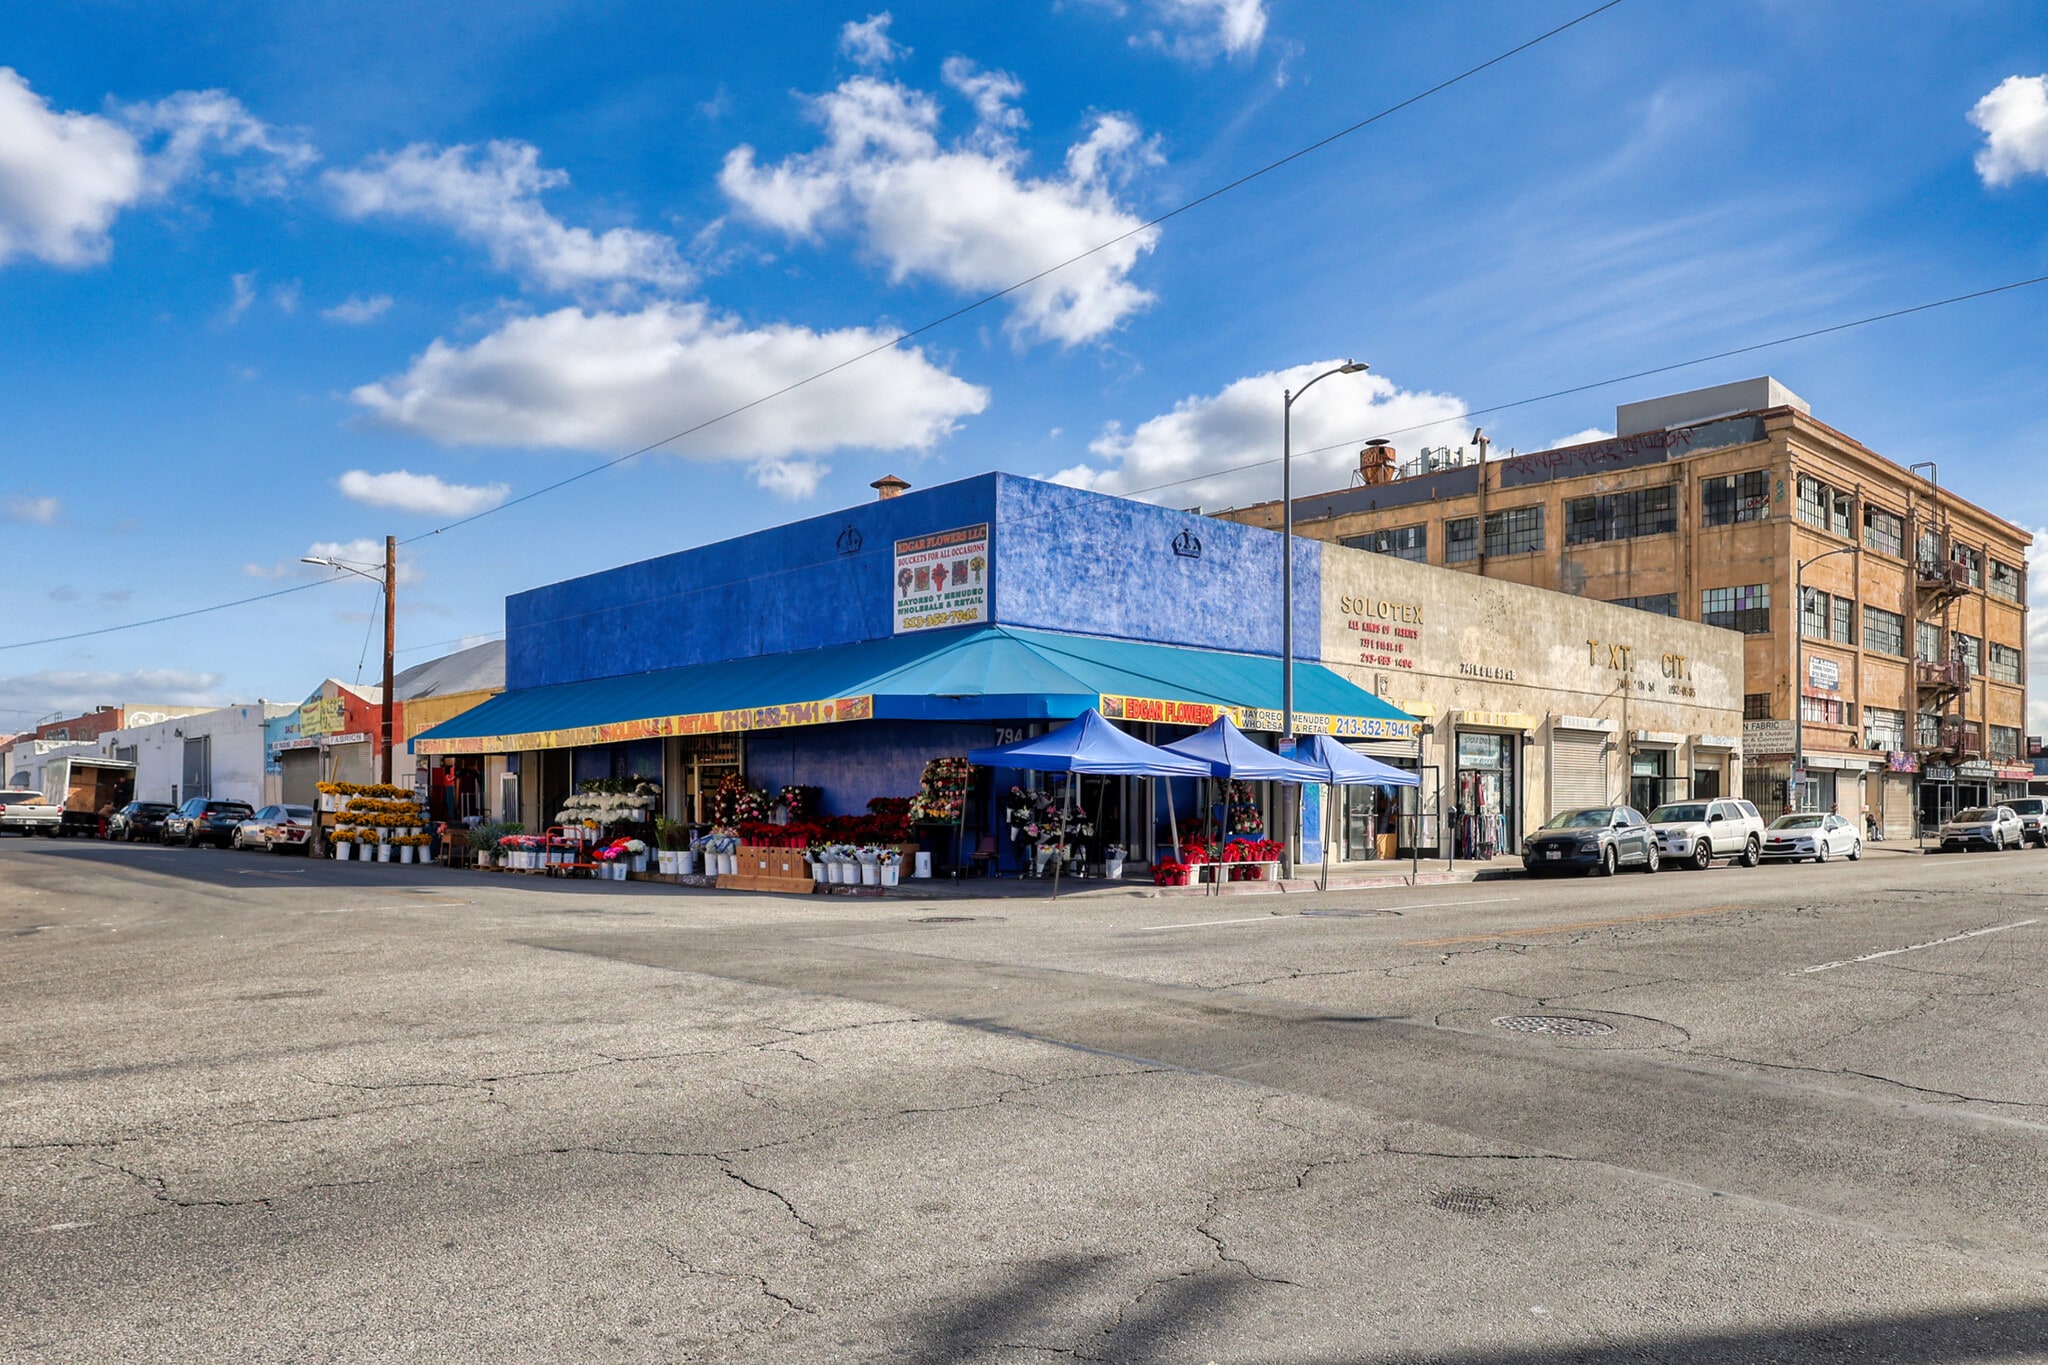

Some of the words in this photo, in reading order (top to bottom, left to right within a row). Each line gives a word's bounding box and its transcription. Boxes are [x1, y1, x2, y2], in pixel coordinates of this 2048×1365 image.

[898, 540, 926, 554] EDGAR
[927, 531, 967, 549] FLOWERS
[967, 527, 985, 539] LLC
[898, 553, 926, 566] BOUCKETS
[928, 551, 938, 560] FOR
[940, 549, 951, 559] ALL
[952, 543, 984, 556] OCCASIONS
[898, 595, 933, 607] MAYOREO
[944, 588, 983, 599] MENUDEO
[898, 602, 943, 615] WHOLESALE
[946, 600, 951, 608] &
[954, 598, 983, 606] RETAIL
[903, 608, 977, 628] 213-352-7941
[1341, 595, 1423, 625] SOLOTEX
[1126, 698, 1163, 720] EDGAR
[1165, 703, 1213, 724] FLOWERS
[1241, 709, 1282, 721] MAYOREO
[1292, 714, 1330, 725] MENUDEO
[600, 719, 659, 741] WHOLESALE
[678, 714, 718, 733] RETAIL
[721, 709, 752, 731] (213)
[756, 703, 818, 727] 352-7941
[1242, 719, 1283, 730] WHOLESA
[1303, 725, 1328, 734] RETAIL
[1336, 718, 1410, 737] 213-352-7941
[1751, 721, 1779, 730] FABRIC
[996, 728, 1022, 746] 794
